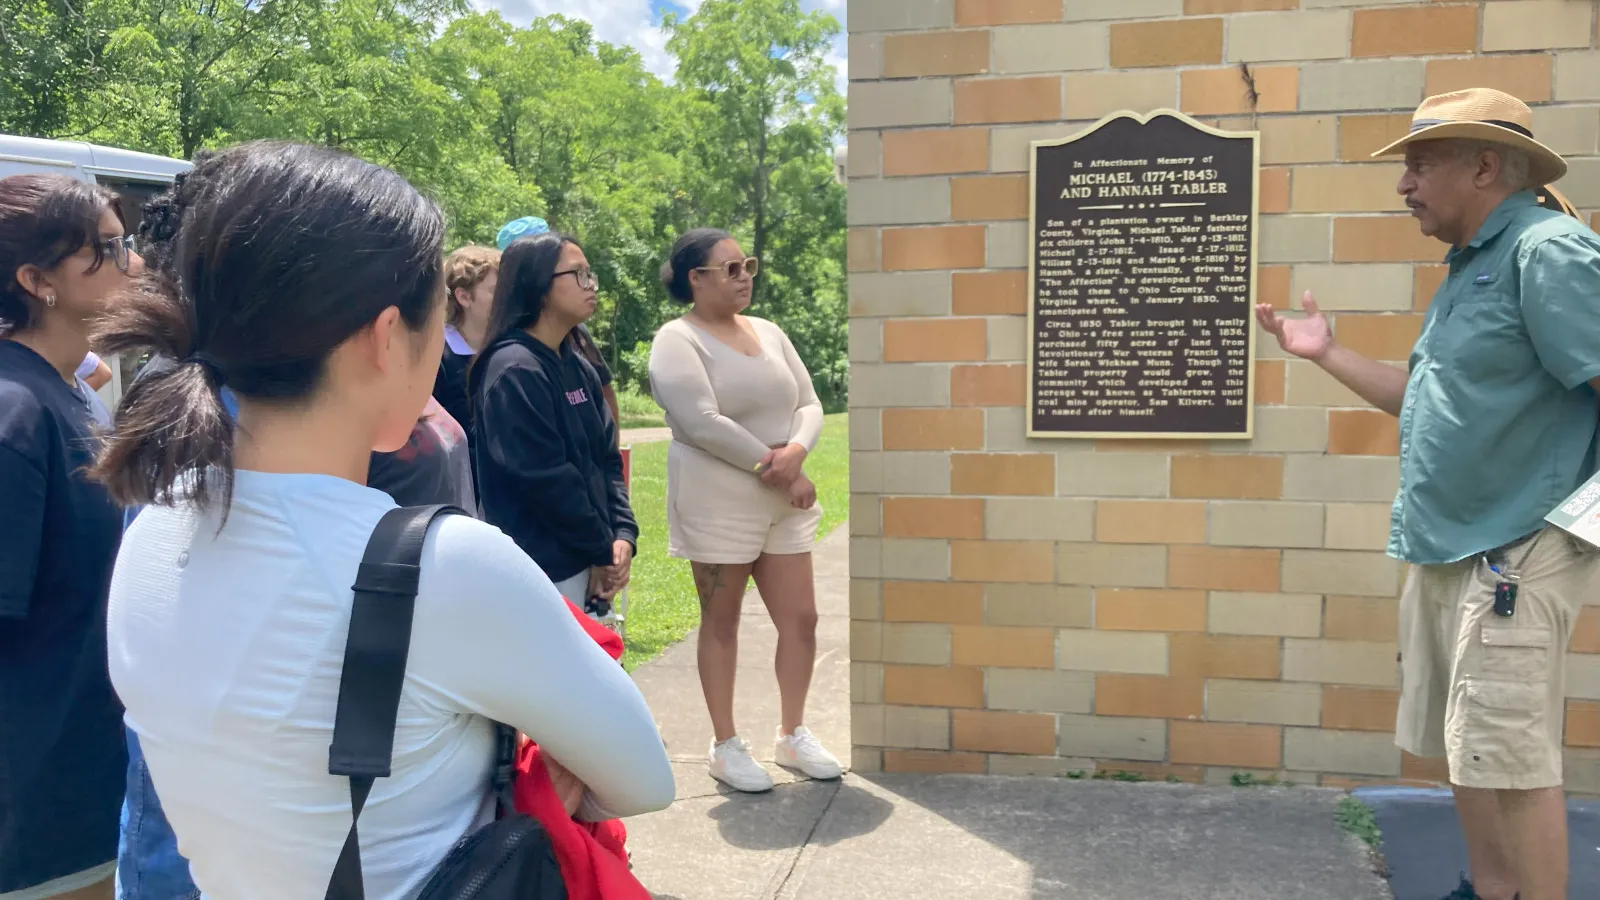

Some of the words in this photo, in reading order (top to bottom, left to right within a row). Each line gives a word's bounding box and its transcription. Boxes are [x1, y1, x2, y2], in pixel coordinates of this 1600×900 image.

[1073, 160, 1083, 168] In
[1090, 158, 1148, 168] Affectionate
[1157, 156, 1194, 166] Memory
[1202, 156, 1213, 164] of
[1069, 172, 1134, 185] MICHAEL
[1142, 169, 1218, 183] (1774-1843)
[1060, 187, 1091, 199] AND
[1098, 185, 1163, 197] HANNAH
[1170, 182, 1228, 195] TABLER
[1047, 219, 1064, 227] Son
[1071, 218, 1082, 227] of
[1100, 217, 1148, 227] plantation
[1155, 216, 1185, 224] owner
[1194, 215, 1202, 223] in
[1130, 226, 1165, 235] Michael
[1171, 225, 1201, 233] Tabler
[1207, 224, 1247, 233] fathered
[1039, 239, 1053, 247] six
[1057, 238, 1095, 246] children
[1040, 249, 1075, 257] Michael
[1159, 246, 1185, 254] Isaac
[1040, 259, 1072, 267] William
[1149, 256, 1176, 264] Maria
[1234, 255, 1247, 264] by
[1193, 265, 1225, 273] driven
[1234, 264, 1247, 274] by
[1124, 277, 1136, 285] he
[1141, 275, 1190, 285] developed
[1196, 275, 1211, 283] for
[1039, 288, 1051, 296] he
[1058, 288, 1079, 296] took
[1118, 287, 1129, 295] to
[1137, 286, 1160, 294] Ohio
[1039, 298, 1077, 307] Virginia
[1131, 296, 1140, 304] in
[1146, 296, 1185, 305] January
[1233, 295, 1245, 303] he
[1039, 308, 1097, 316] emancipated
[1045, 320, 1072, 328] Circa
[1079, 320, 1102, 328] 1830
[1110, 319, 1141, 327] Tabler
[1147, 319, 1185, 328] brought
[1193, 319, 1207, 327] his
[1215, 318, 1245, 328] family
[1058, 330, 1081, 338] Ohio
[1102, 329, 1123, 337] free
[1130, 329, 1154, 337] state
[1039, 339, 1086, 349] purchased
[1096, 339, 1119, 348] fifty
[1191, 338, 1211, 346] land
[1221, 338, 1245, 346] from
[1039, 349, 1105, 359] Revolutionary
[1113, 349, 1130, 357] War
[1137, 349, 1173, 357] veteran
[1038, 359, 1058, 367] wife
[1064, 359, 1091, 367] Sarah
[1098, 359, 1140, 367] Wickham
[1187, 358, 1222, 367] Though
[1038, 369, 1068, 377] Tabler
[1083, 369, 1128, 378] property
[1143, 368, 1171, 376] would
[1228, 368, 1244, 376] the
[1038, 379, 1088, 387] community
[1097, 378, 1126, 387] which
[1138, 378, 1188, 387] developed
[1226, 378, 1244, 386] this
[1038, 389, 1076, 398] acreage
[1082, 389, 1099, 397] was
[1106, 388, 1135, 397] known
[1142, 389, 1153, 397] as
[1161, 388, 1216, 397] Tablertown
[1221, 388, 1244, 396] until
[1038, 398, 1058, 406] coal
[1067, 398, 1087, 406] mine
[1149, 398, 1168, 406] Sam
[1226, 398, 1243, 406] had
[1038, 408, 1046, 416] it
[1052, 408, 1081, 416] named
[1088, 408, 1113, 416] after
